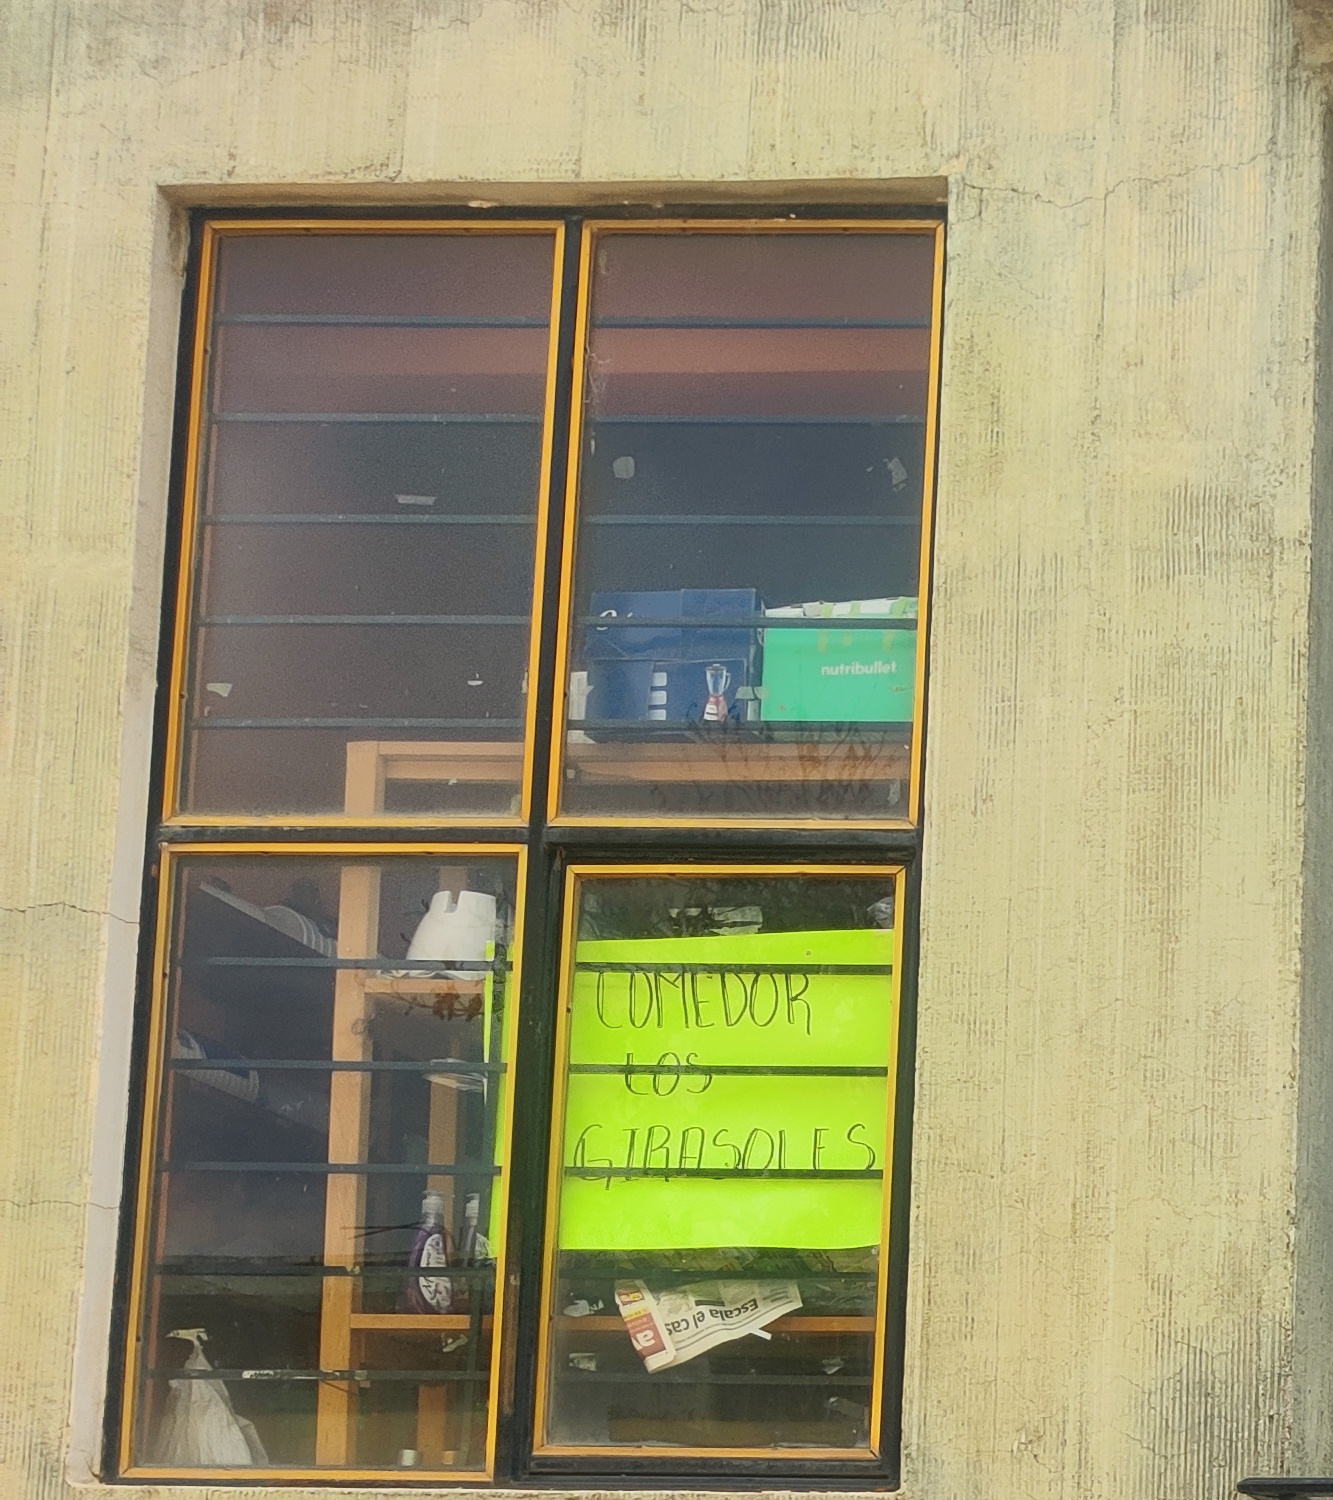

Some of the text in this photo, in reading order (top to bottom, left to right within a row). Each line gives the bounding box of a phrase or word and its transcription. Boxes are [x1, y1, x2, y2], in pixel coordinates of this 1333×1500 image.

[821, 661, 897, 676] nutribullet
[596, 964, 811, 1036] COMEDOR
[624, 1052, 713, 1096] LOS
[694, 1309, 706, 1329] el
[709, 1298, 759, 1321] Escala
